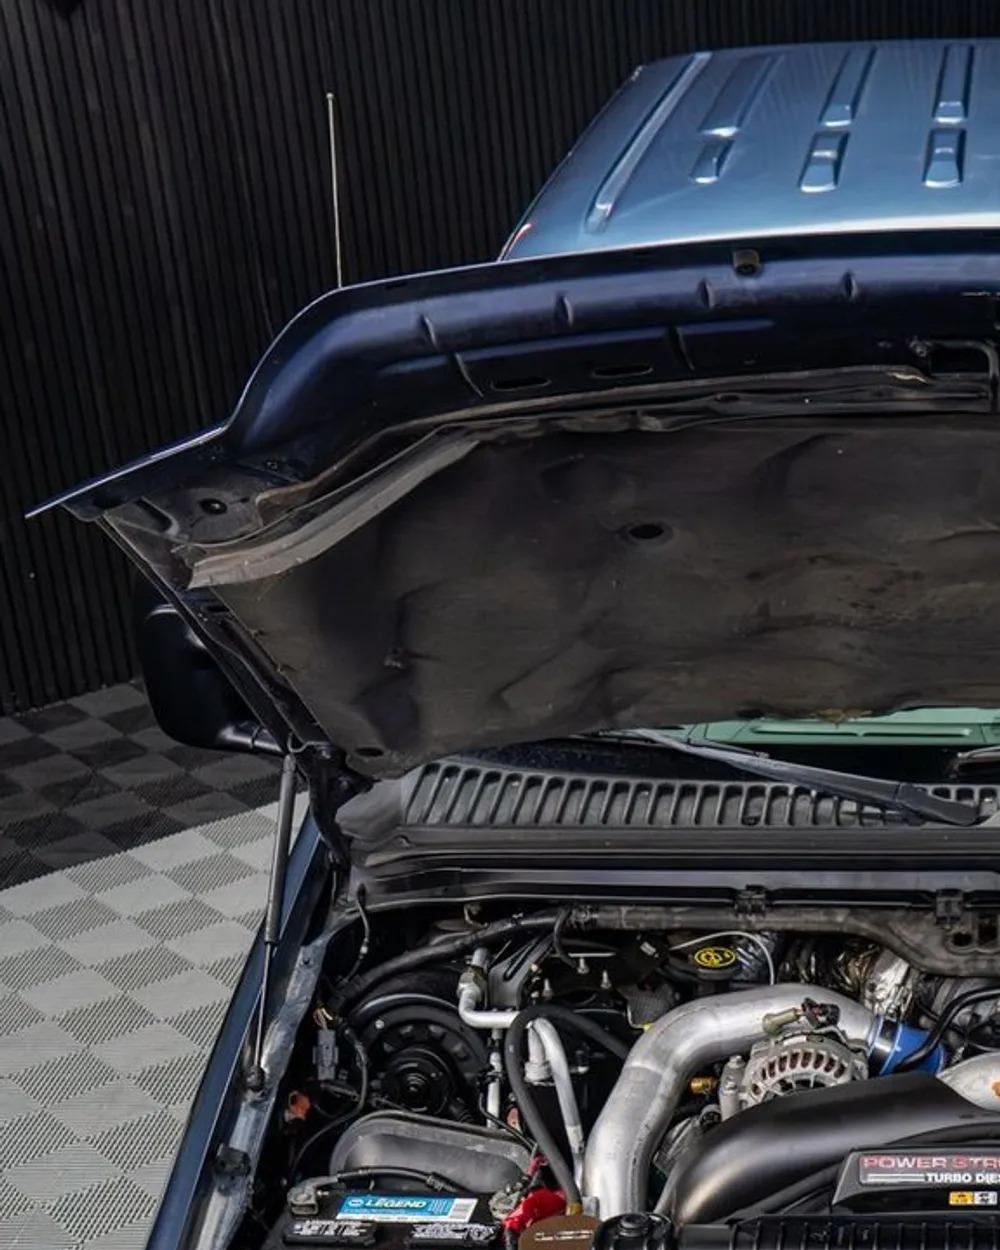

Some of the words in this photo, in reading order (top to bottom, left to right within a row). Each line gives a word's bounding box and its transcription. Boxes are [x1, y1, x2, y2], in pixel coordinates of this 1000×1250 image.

[863, 1155, 947, 1169] POWER
[925, 1172, 972, 1184] TURBO
[365, 1198, 428, 1209] LEGEND
